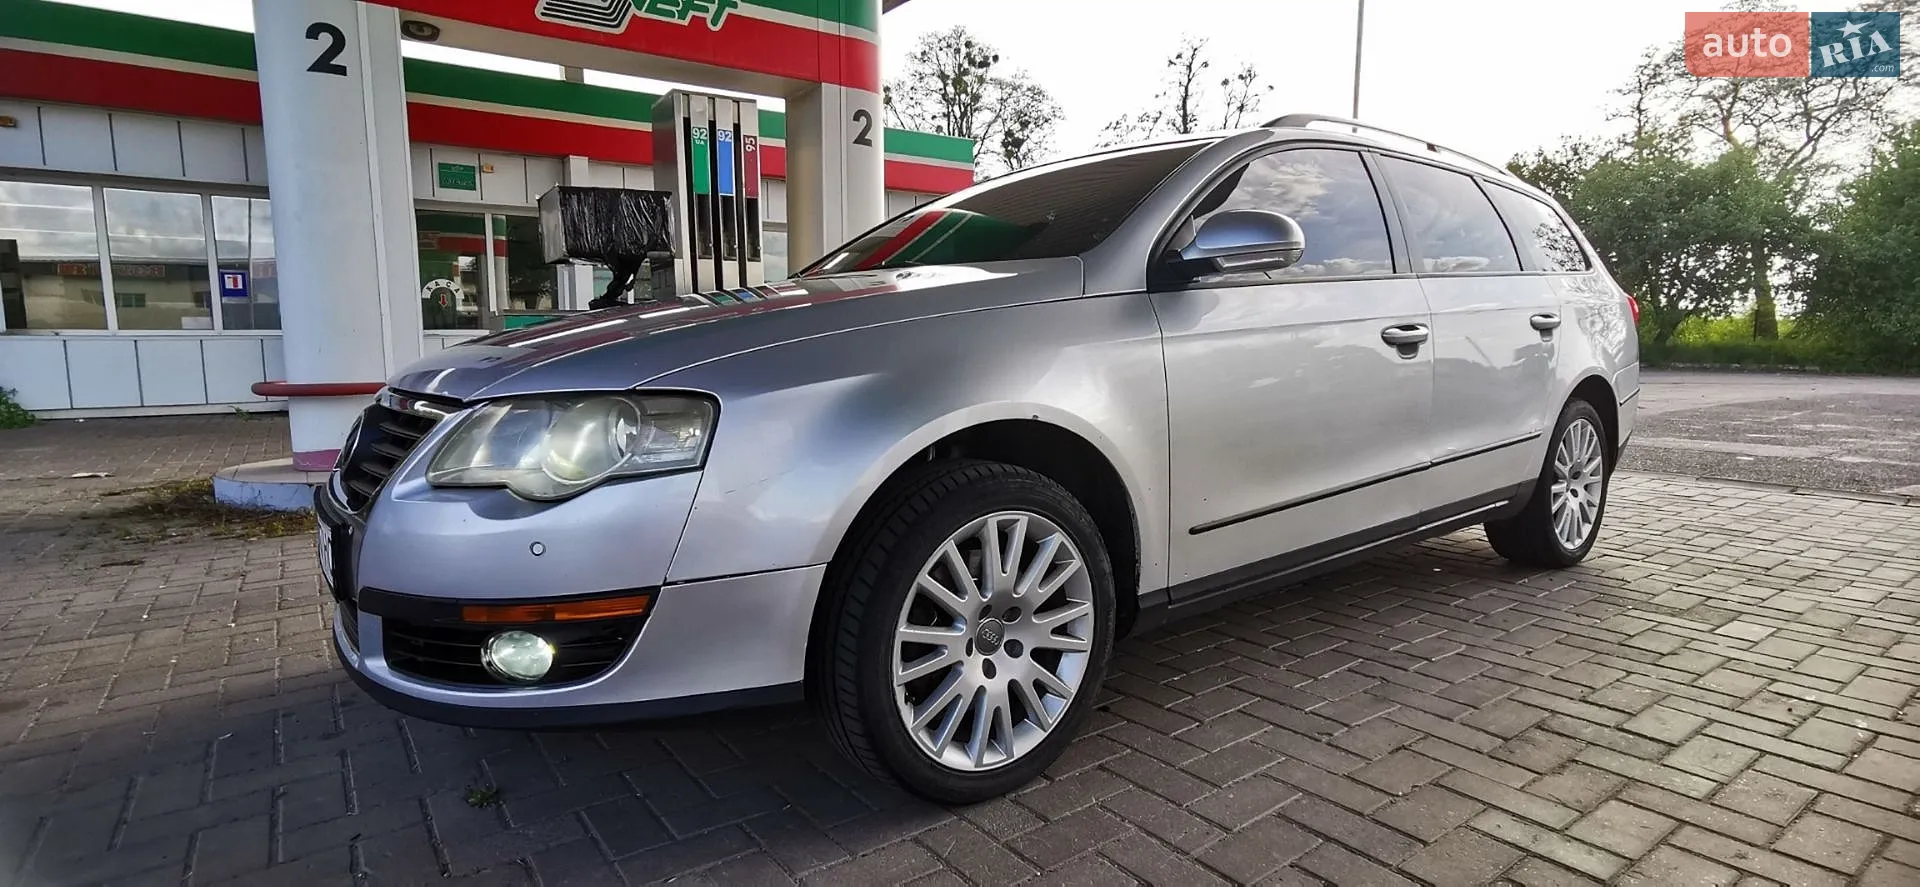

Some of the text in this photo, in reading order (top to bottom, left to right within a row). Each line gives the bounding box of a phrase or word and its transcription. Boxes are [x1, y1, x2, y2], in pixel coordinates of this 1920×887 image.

[305, 22, 347, 76] 2
[692, 127, 707, 140] 92
[718, 130, 732, 142] 92
[853, 109, 872, 147] 2
[745, 136, 756, 152] 95
